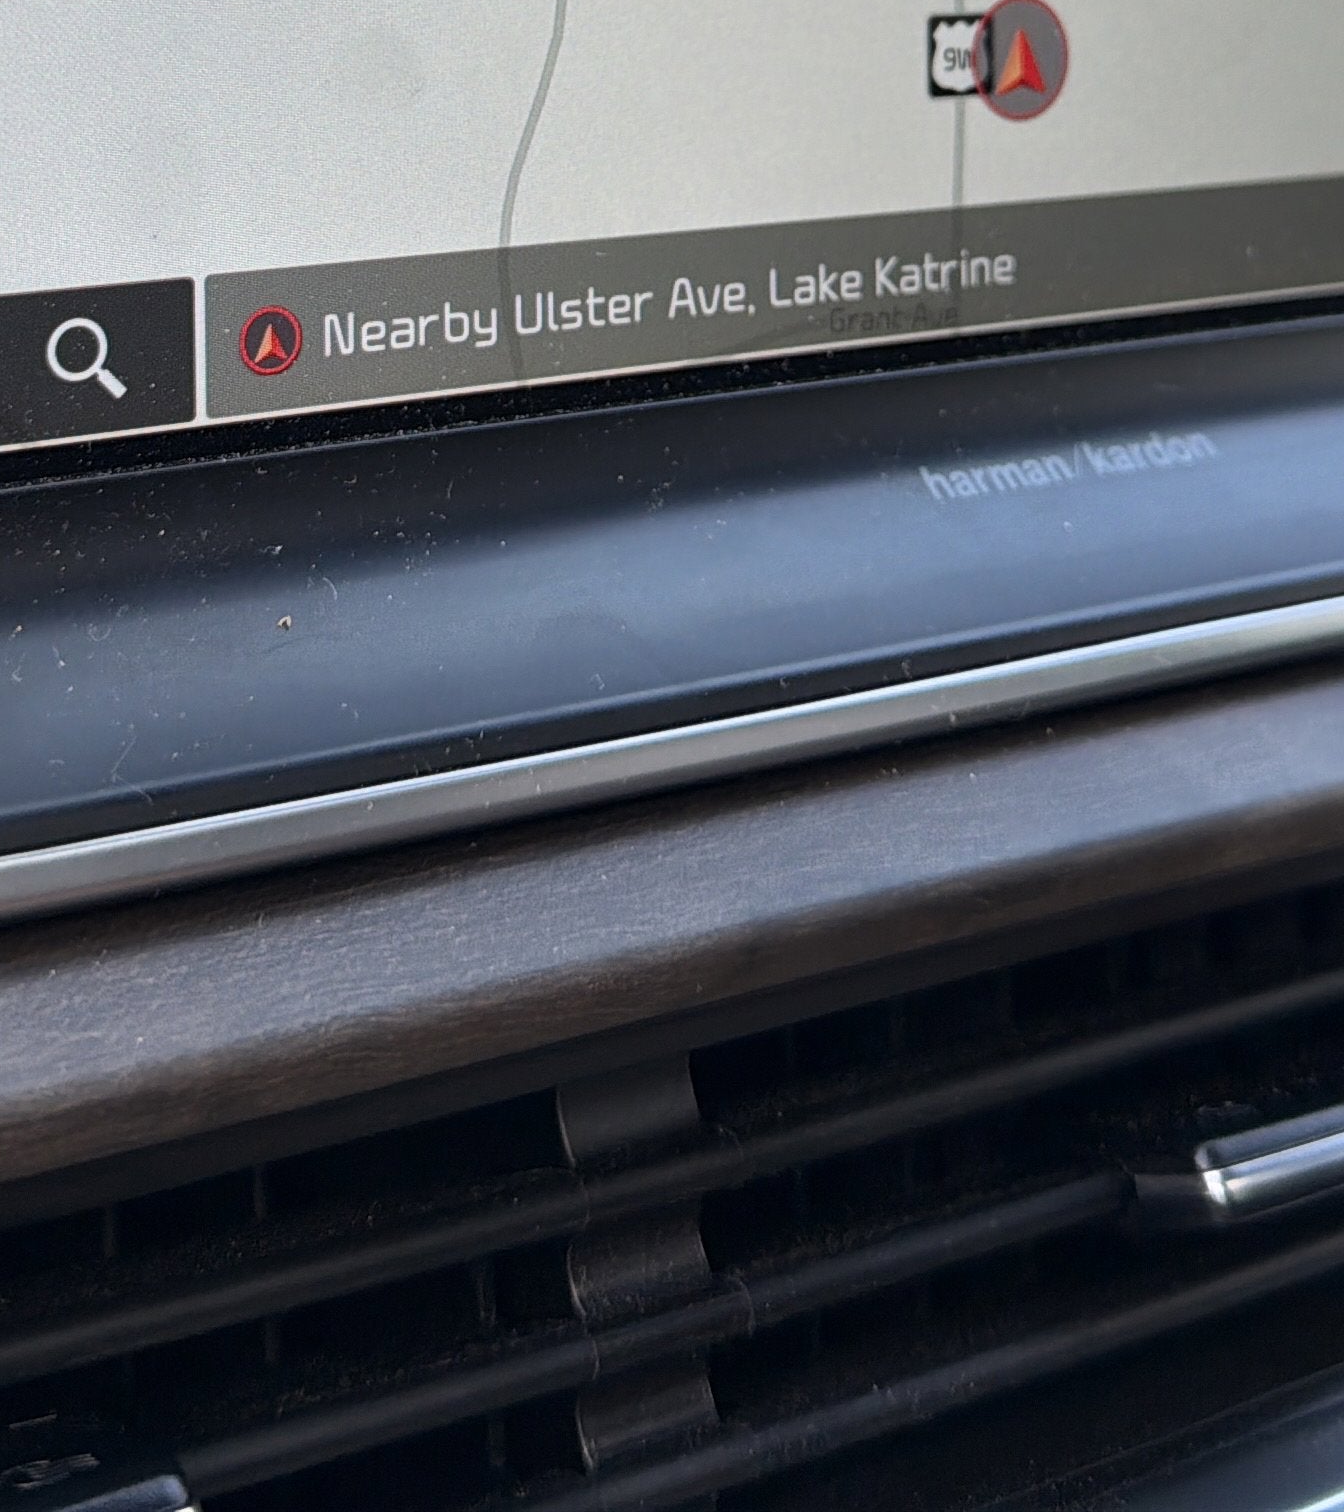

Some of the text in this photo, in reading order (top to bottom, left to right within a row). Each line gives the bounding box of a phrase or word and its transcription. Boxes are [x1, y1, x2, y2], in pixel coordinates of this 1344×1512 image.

[323, 305, 499, 359] Nearby
[515, 288, 654, 337] Ulster
[769, 265, 864, 310] Lake
[874, 248, 1018, 299] Katrine
